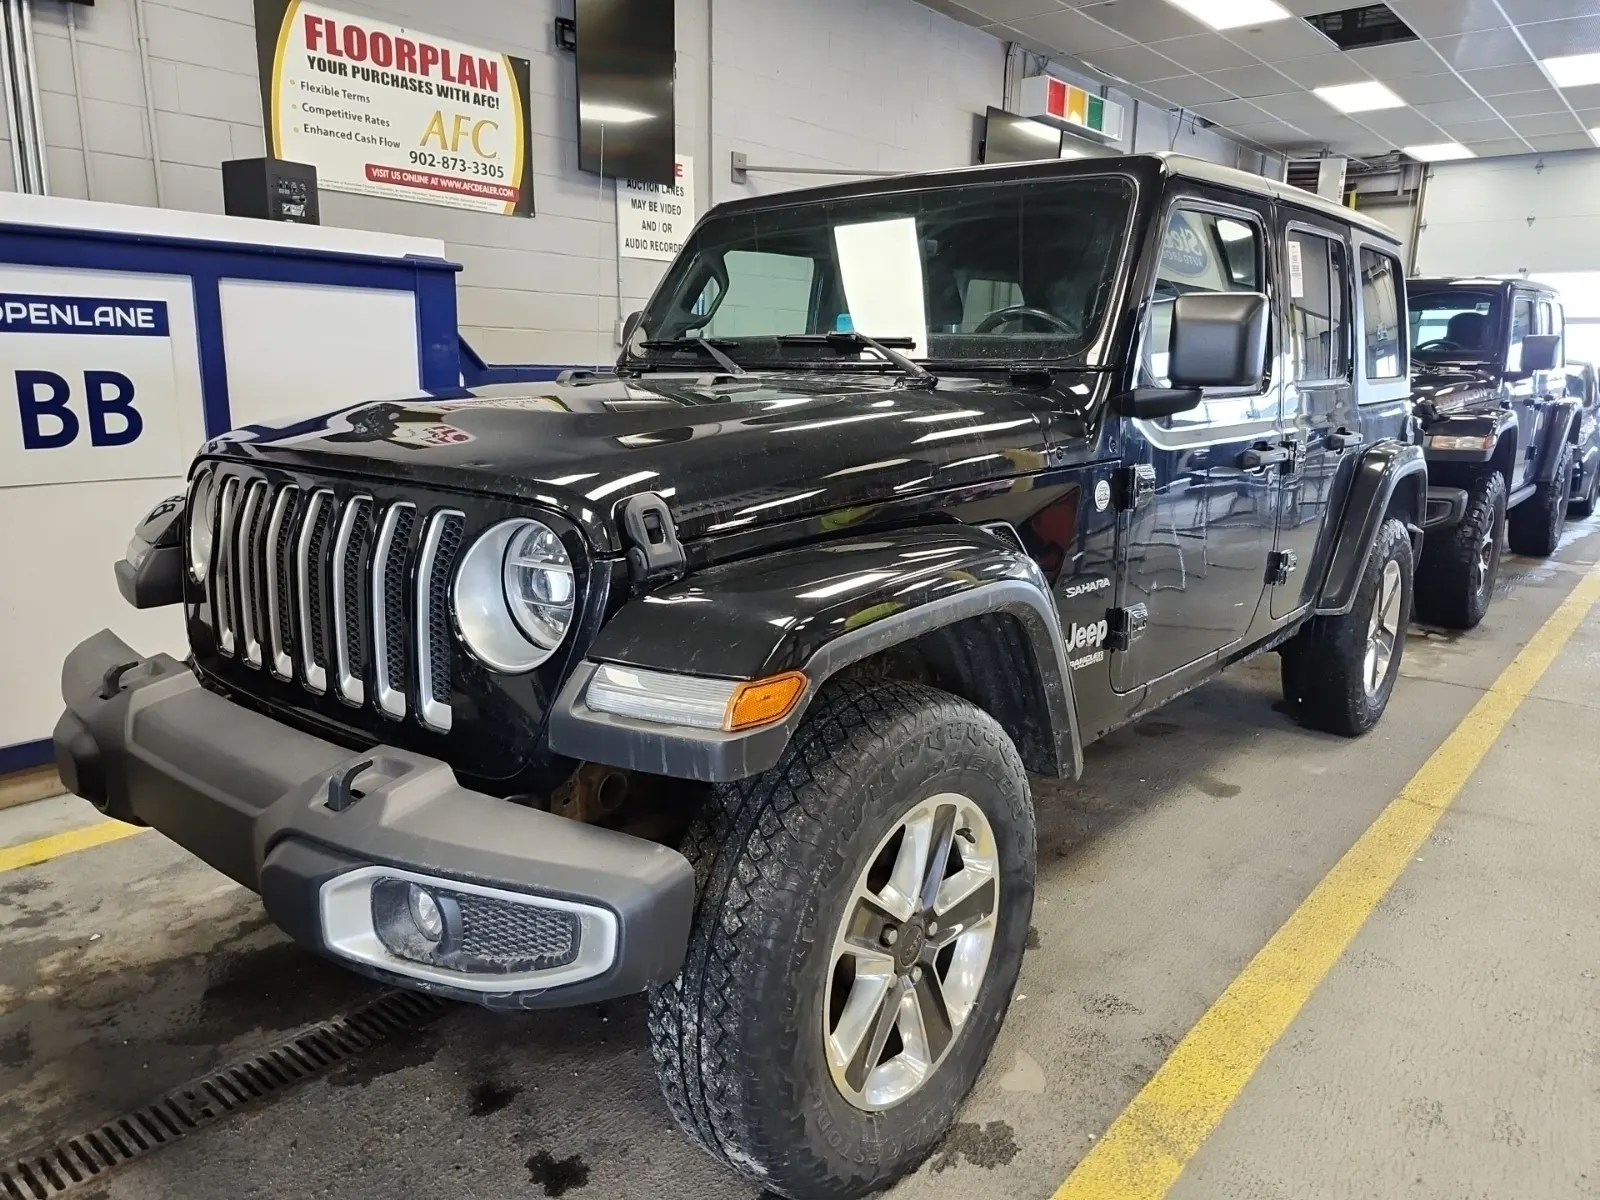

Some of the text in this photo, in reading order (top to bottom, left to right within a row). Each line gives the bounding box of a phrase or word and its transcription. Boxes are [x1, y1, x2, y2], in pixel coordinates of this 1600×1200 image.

[304, 14, 498, 92] FLOORPLAN
[300, 80, 371, 104] Flexible Terms
[307, 55, 500, 110] YOUR PURCHASES WITH AFC!
[301, 102, 391, 128] Competitive Rates
[303, 123, 401, 149] Enhanced Cash Flow
[419, 110, 499, 159] AFC
[409, 150, 504, 179] 902-873-3305
[371, 168, 515, 198] VISIT US ONLINE AT WWW.AFCDEALER.COM
[627, 179, 685, 197] AUCTION LANES
[631, 198, 682, 215] MAY BE VIDEO
[641, 220, 657, 231] AND
[662, 222, 673, 233] OR
[625, 237, 684, 254] AUDIO RECORDE
[0, 302, 155, 328] PENLANE
[14, 369, 144, 450] BB
[1065, 577, 1110, 598] SAHARA
[1065, 619, 1108, 653] Jeep
[1069, 650, 1104, 667] RANGLER
